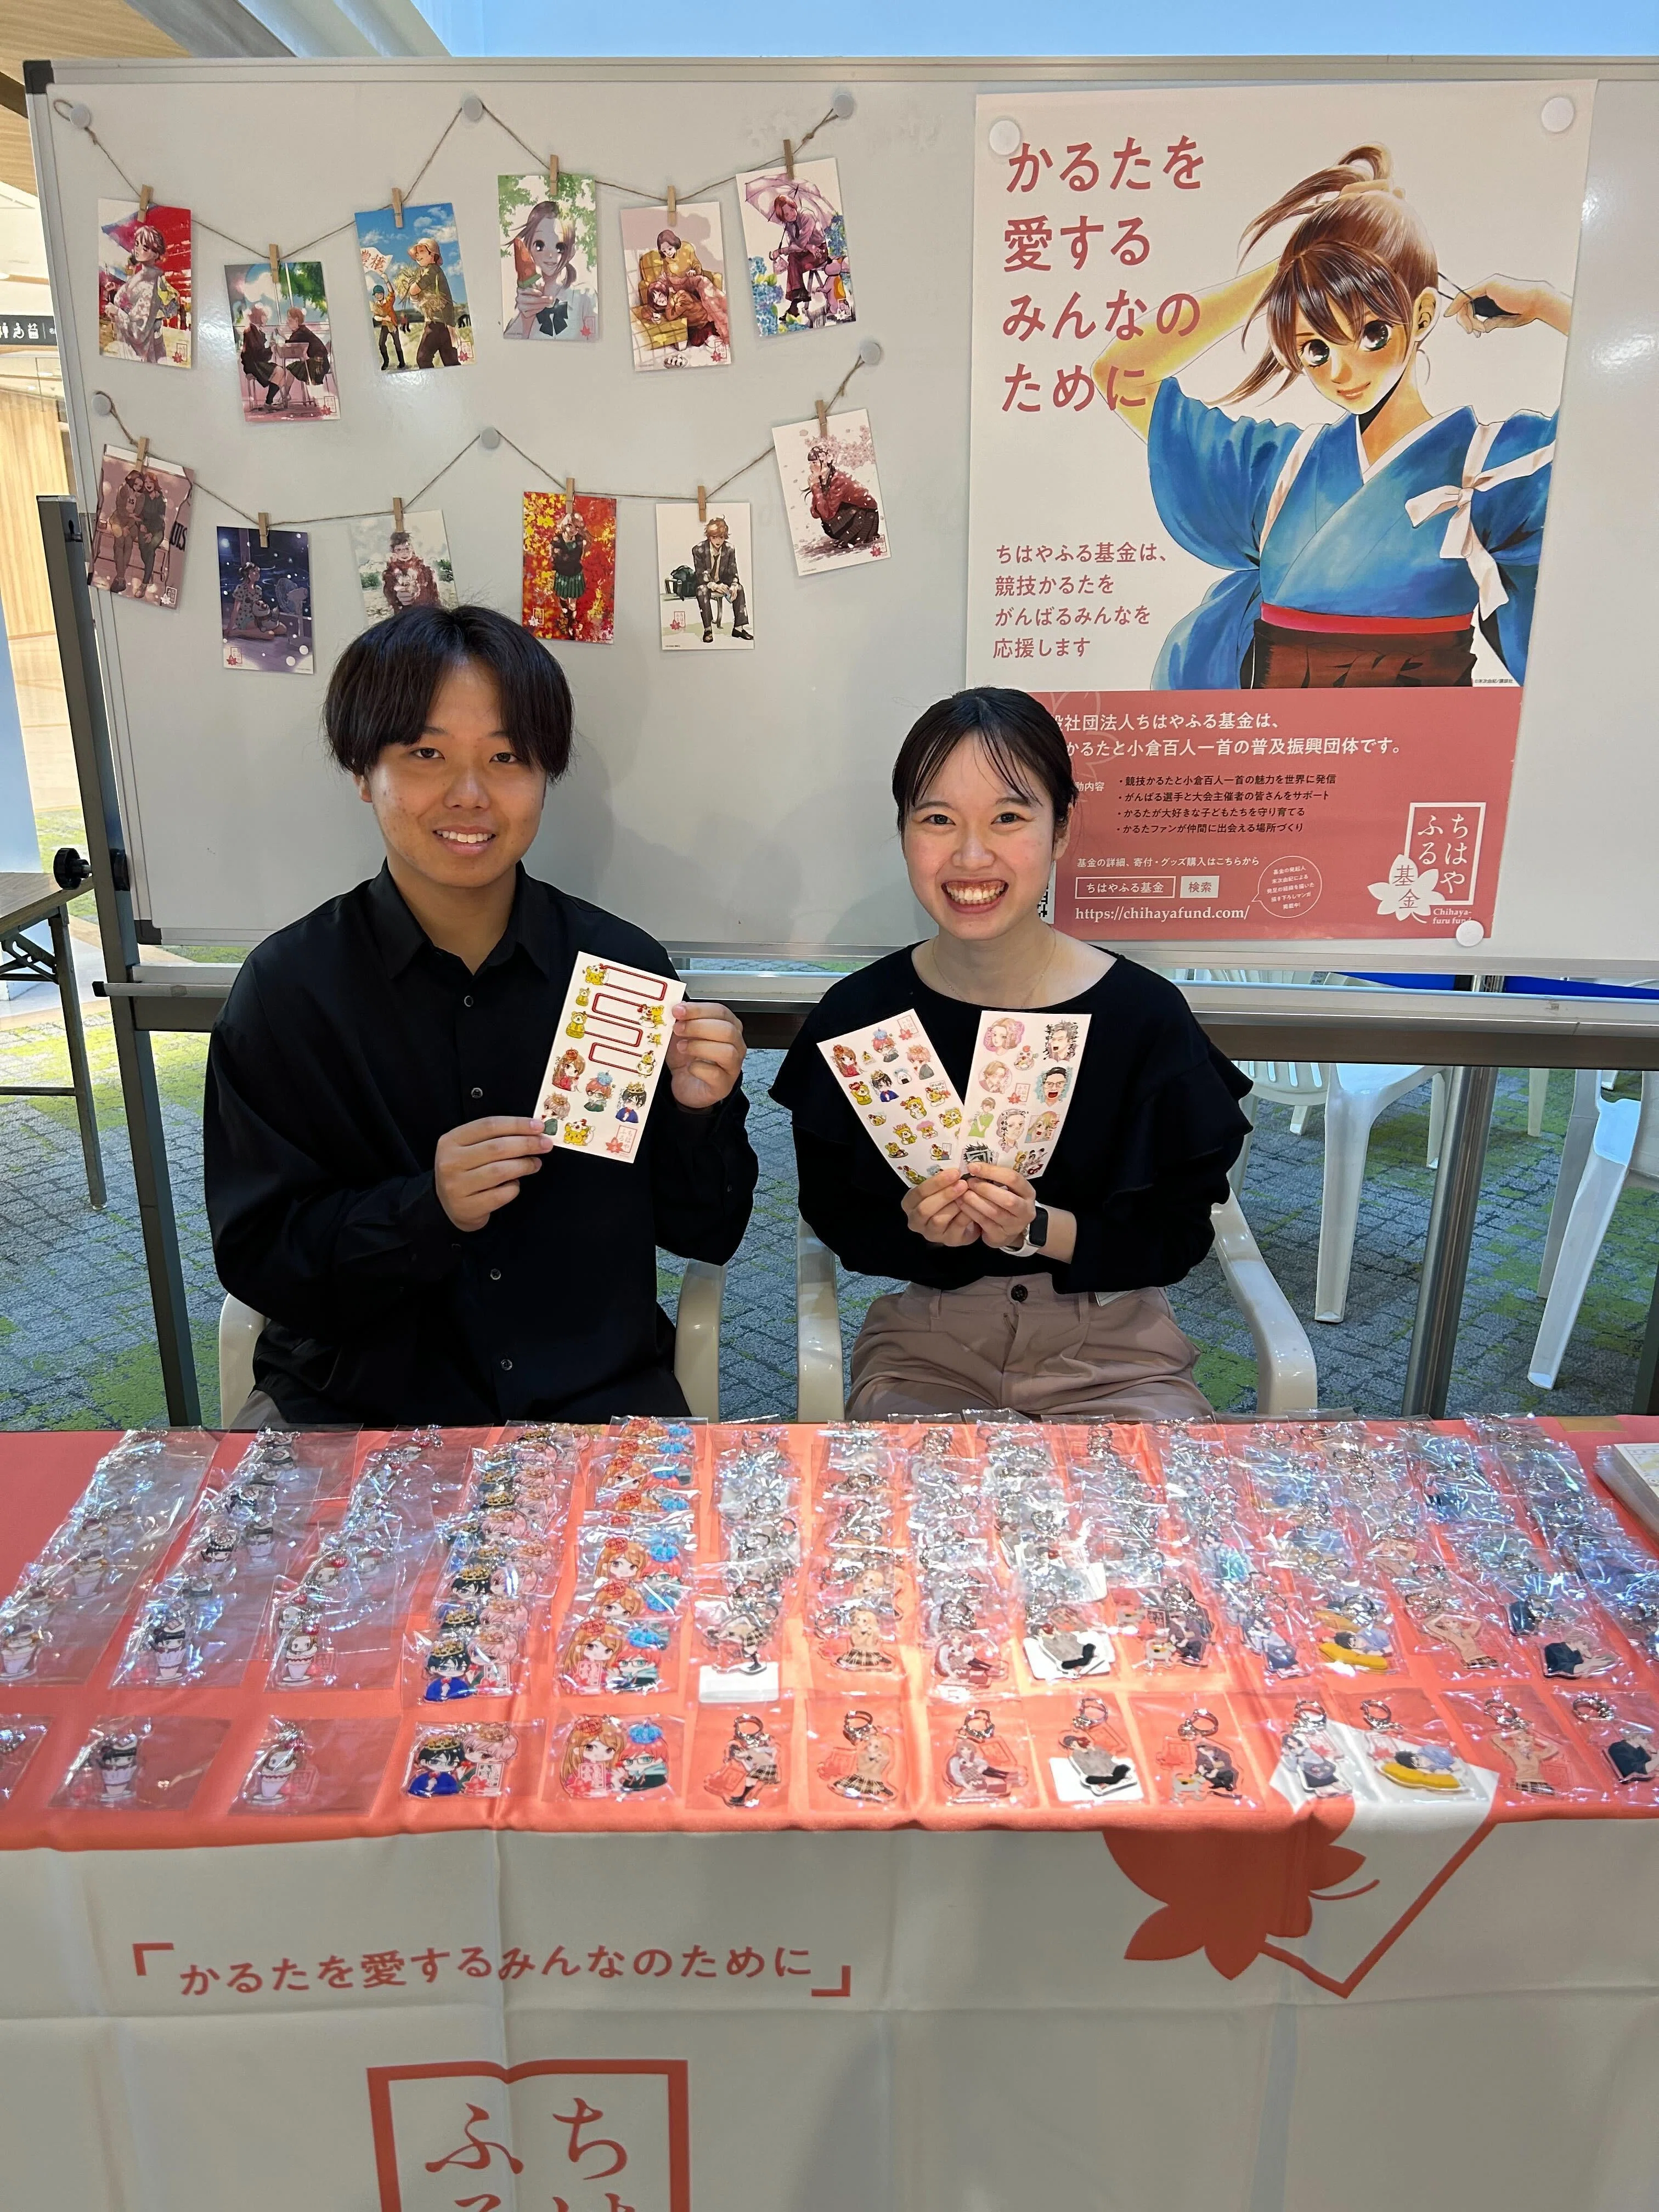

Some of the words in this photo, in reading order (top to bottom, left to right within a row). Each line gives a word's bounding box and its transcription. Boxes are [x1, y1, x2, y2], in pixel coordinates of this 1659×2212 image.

[1006, 134, 1204, 193] かるたを
[1004, 215, 1151, 273] 愛する
[1002, 289, 1201, 341] みんなの
[1001, 362, 1147, 413] ために
[996, 541, 1167, 565] ちはやふる基金は、
[995, 574, 1115, 597] 競技かるたを
[995, 605, 1150, 627] がんばるみんなを
[992, 637, 1091, 659] 応援します
[1066, 737, 1400, 757] かるたと小倉百人一首の普及振興団体です。
[1418, 815, 1444, 865] ふる
[1440, 813, 1469, 894] ちはや
[1086, 882, 1164, 894] ちはやふる基金
[1188, 882, 1212, 893] 検索
[1392, 865, 1421, 909] 基金
[1075, 905, 1250, 922] https://chihayafund.com/
[1433, 908, 1472, 917] Chihaya-
[132, 1942, 851, 1997] 「かるたを愛するみんなのために」
